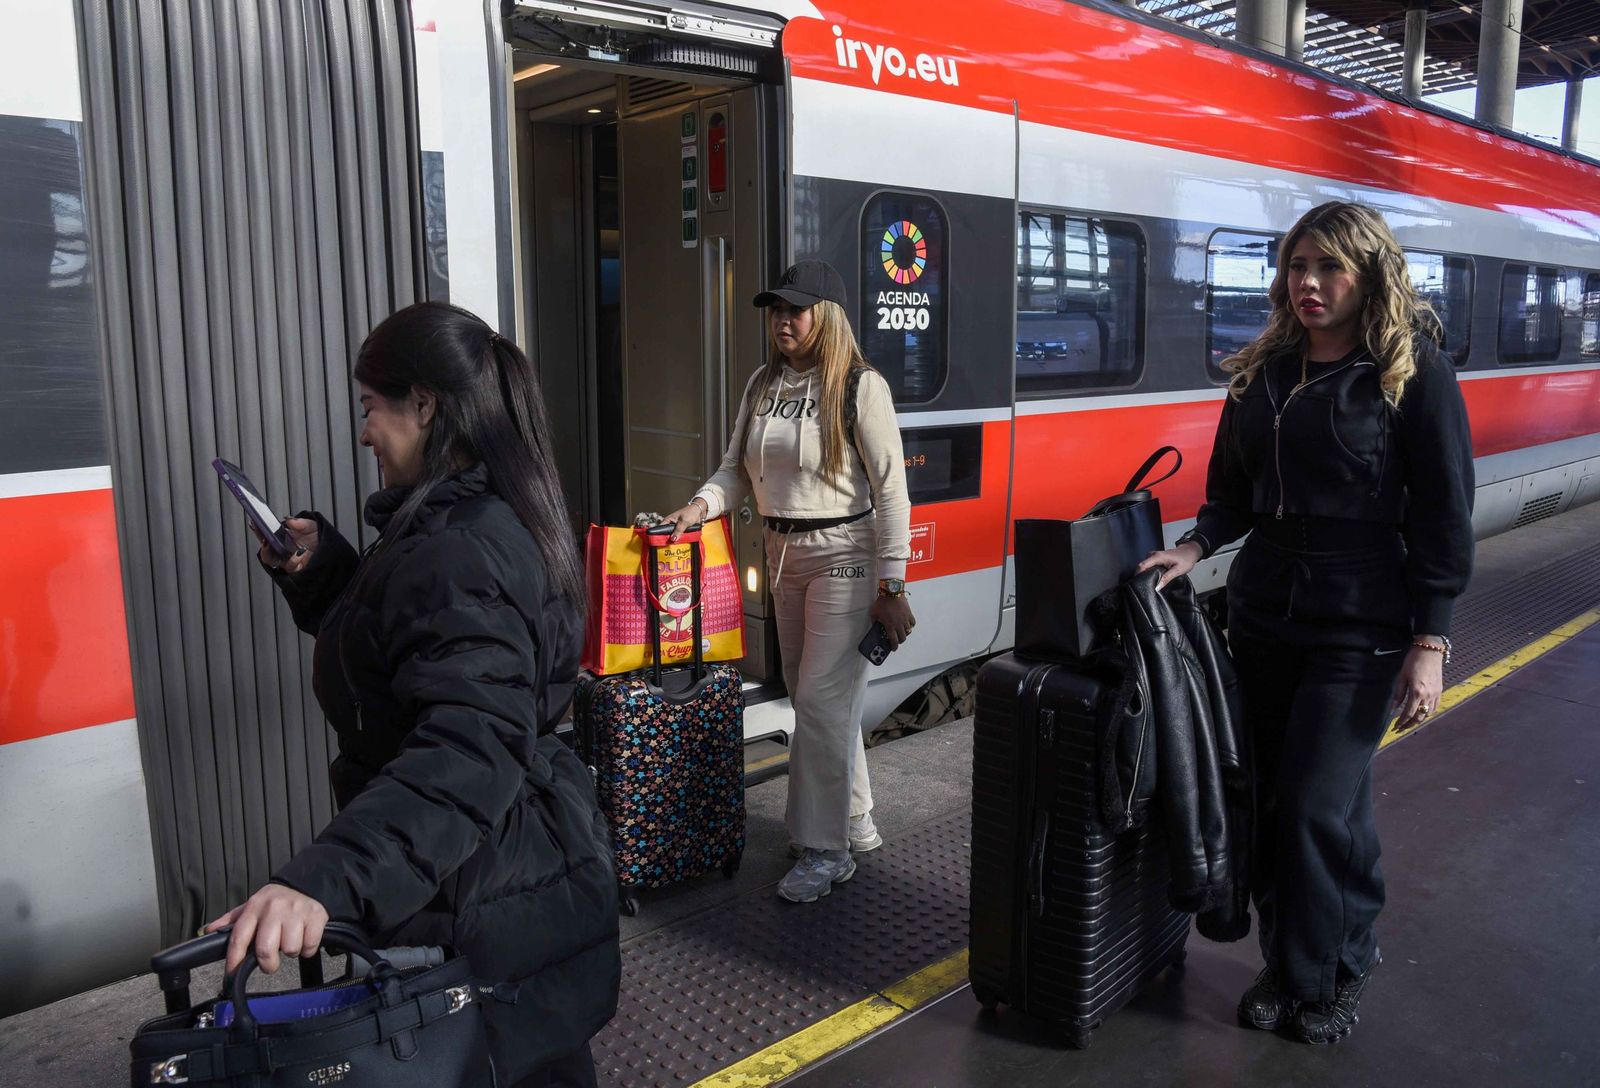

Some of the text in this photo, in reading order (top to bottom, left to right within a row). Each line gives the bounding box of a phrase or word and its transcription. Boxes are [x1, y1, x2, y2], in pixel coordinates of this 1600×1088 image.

[831, 24, 959, 87] iryo.eu
[876, 290, 931, 306] AGENDA
[876, 306, 930, 331] 2030
[756, 396, 817, 420] DIOR
[829, 566, 866, 579] DIOR
[307, 1060, 352, 1082] GUESS
